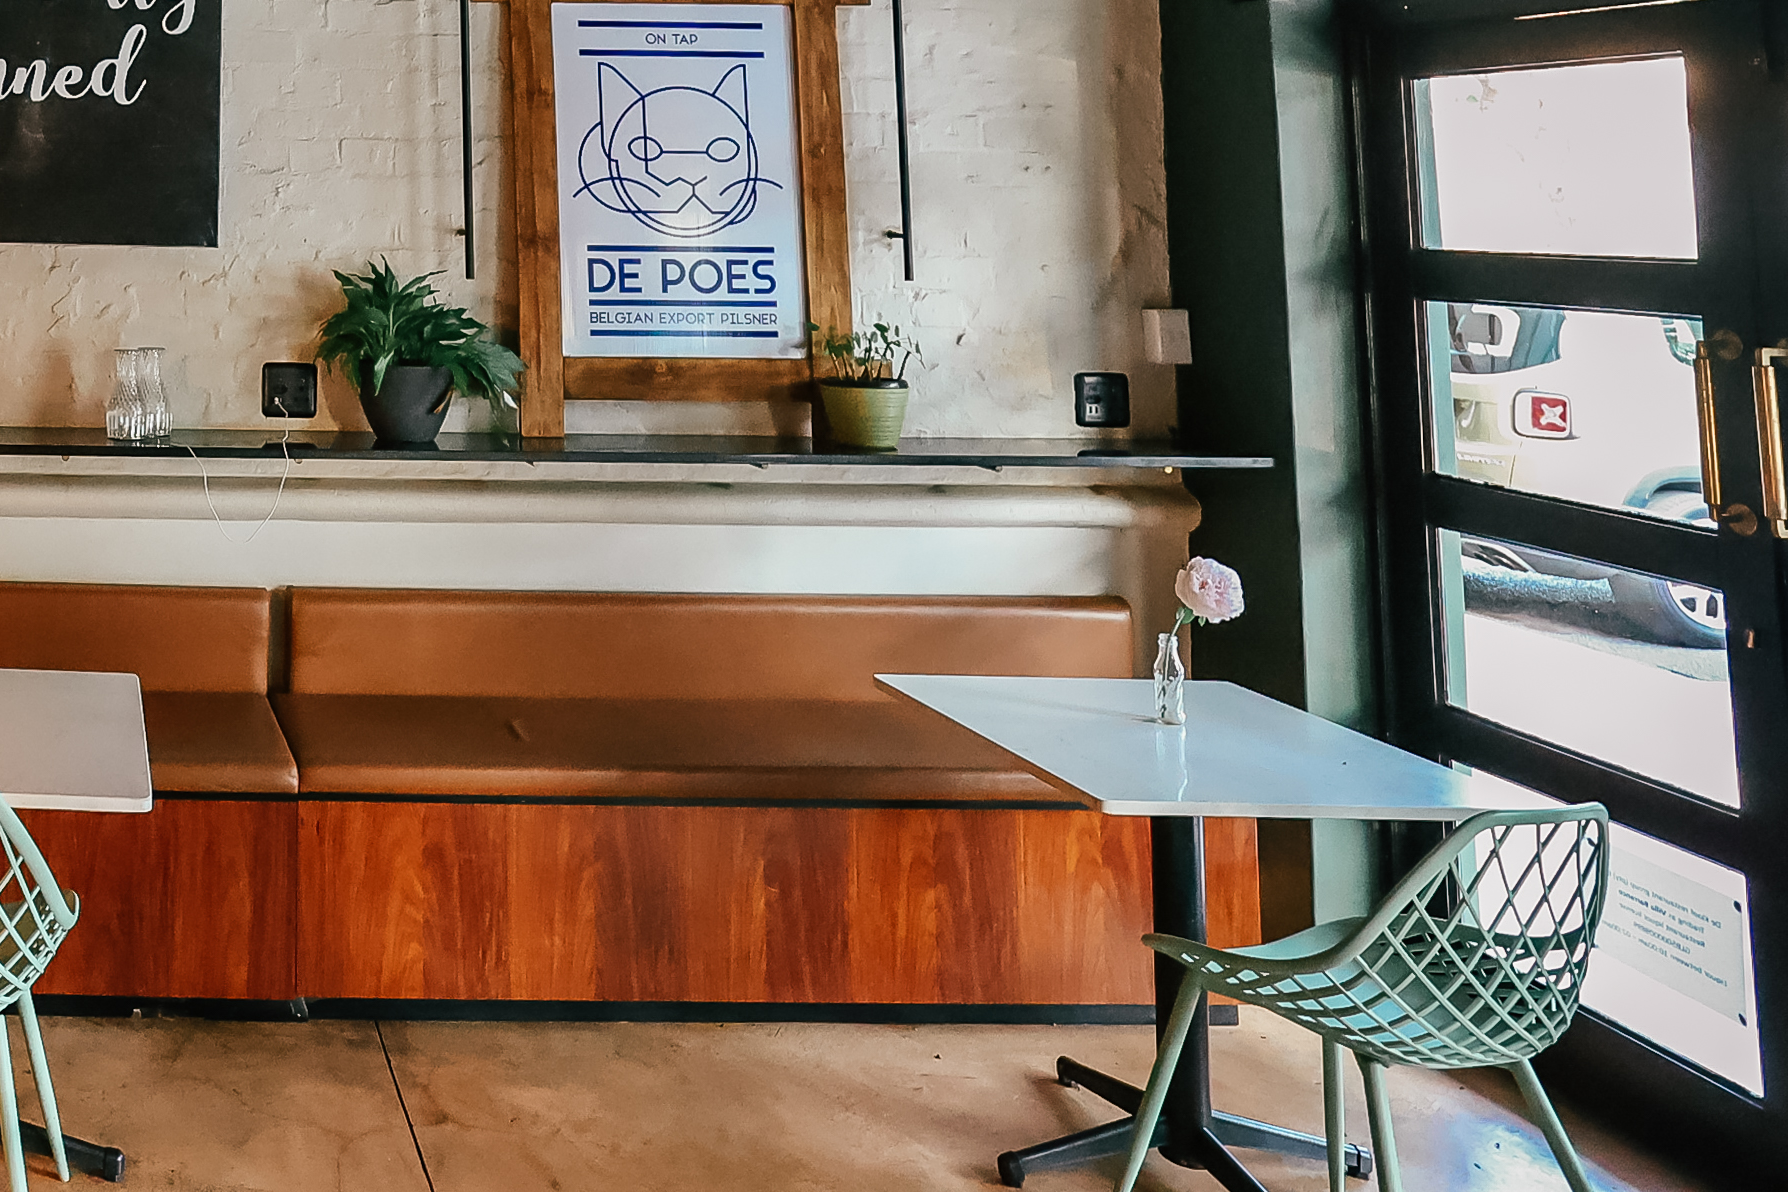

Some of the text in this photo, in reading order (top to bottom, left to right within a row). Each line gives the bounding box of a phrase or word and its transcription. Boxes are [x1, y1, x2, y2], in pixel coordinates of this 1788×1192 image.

[645, 33, 698, 46] ON TAP
[587, 257, 777, 295] DE POES
[589, 311, 778, 326] BELGIAN EXPORT PILSNER
